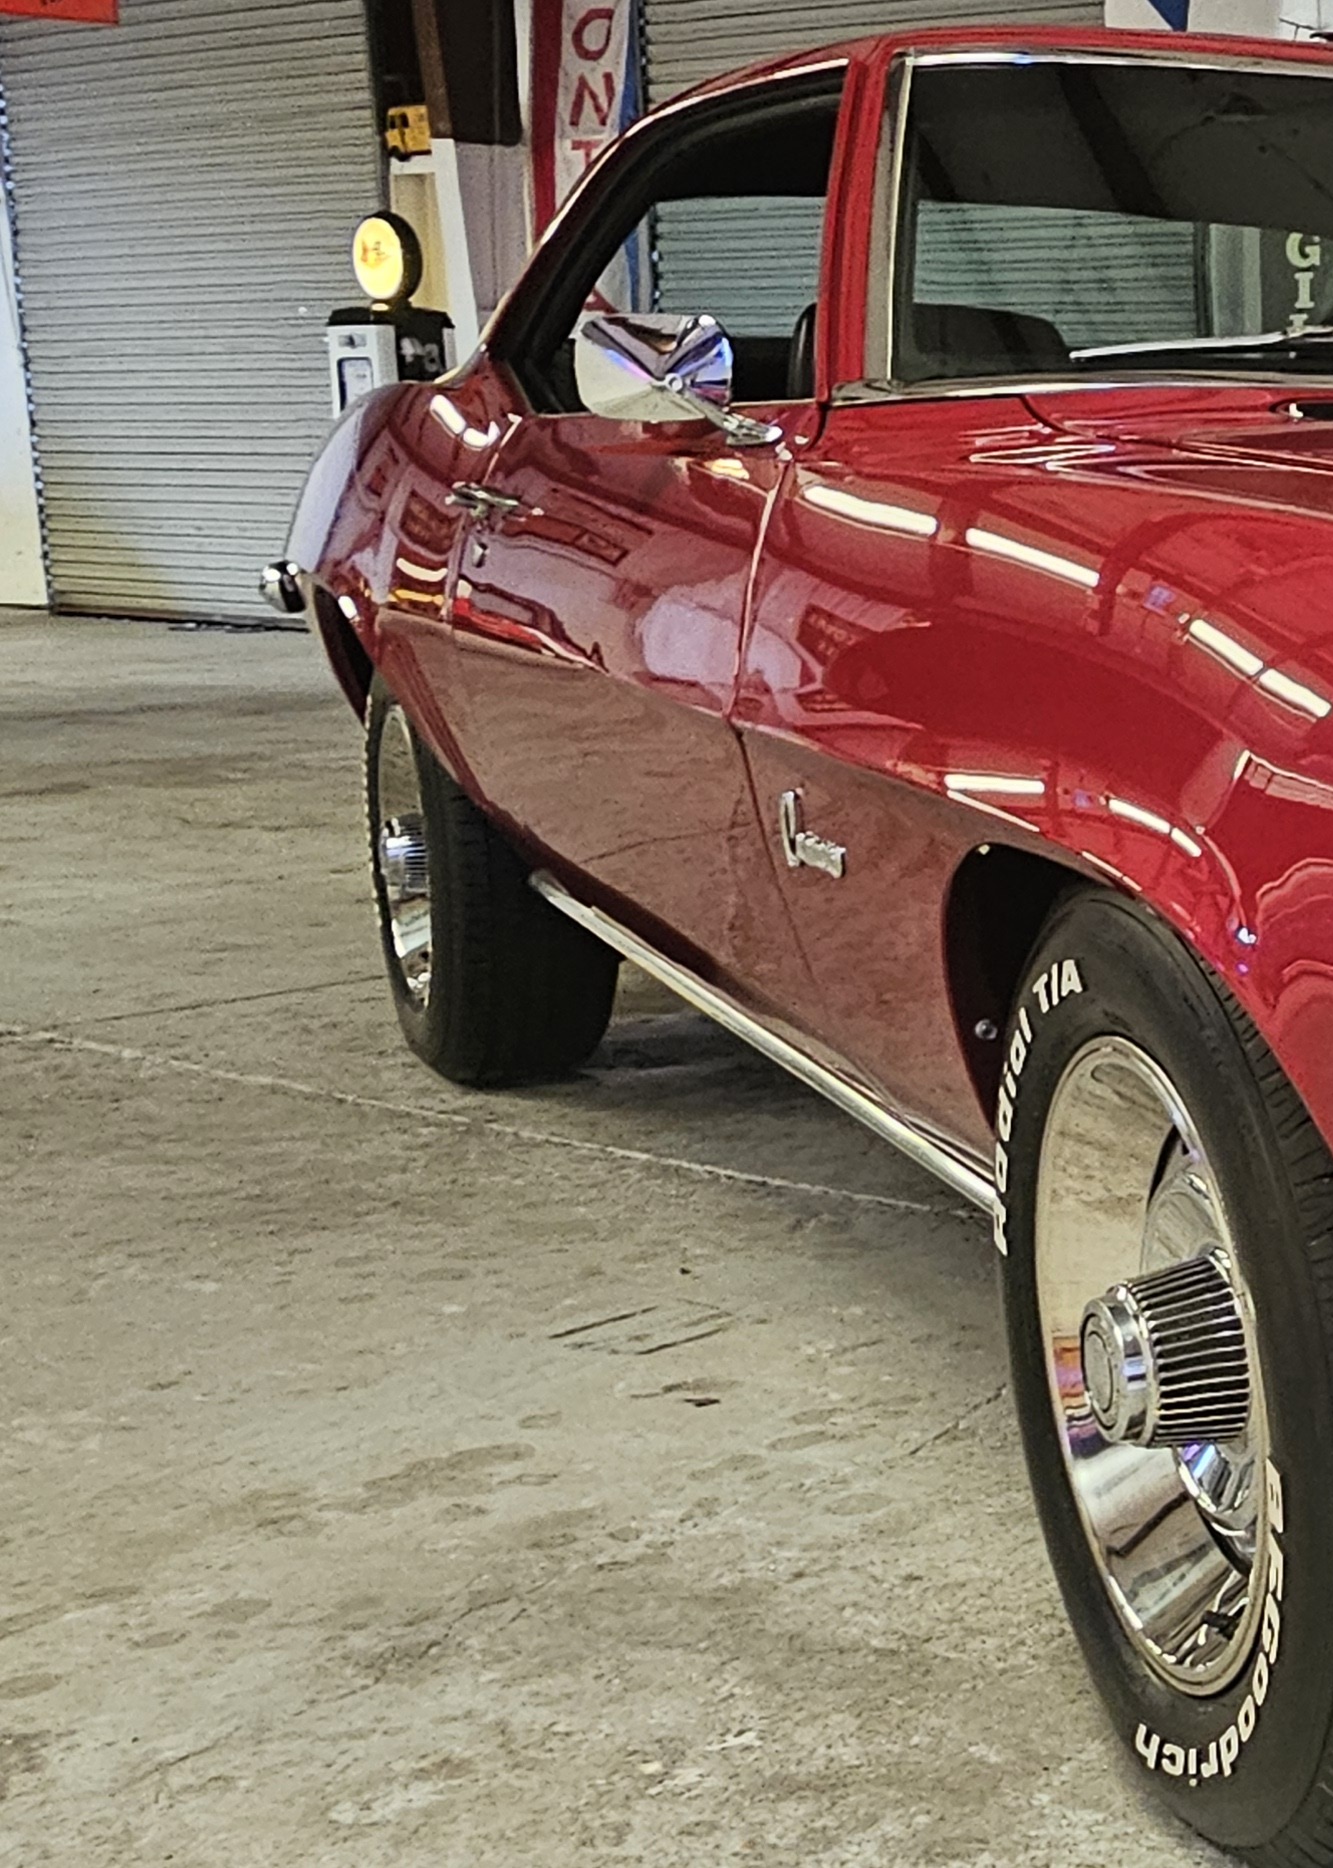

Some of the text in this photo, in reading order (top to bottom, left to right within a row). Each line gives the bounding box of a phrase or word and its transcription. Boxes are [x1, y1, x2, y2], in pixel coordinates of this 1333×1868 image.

[993, 959, 1083, 1257] Radial T/A
[1135, 1458, 1284, 1787] BFGoodrich
